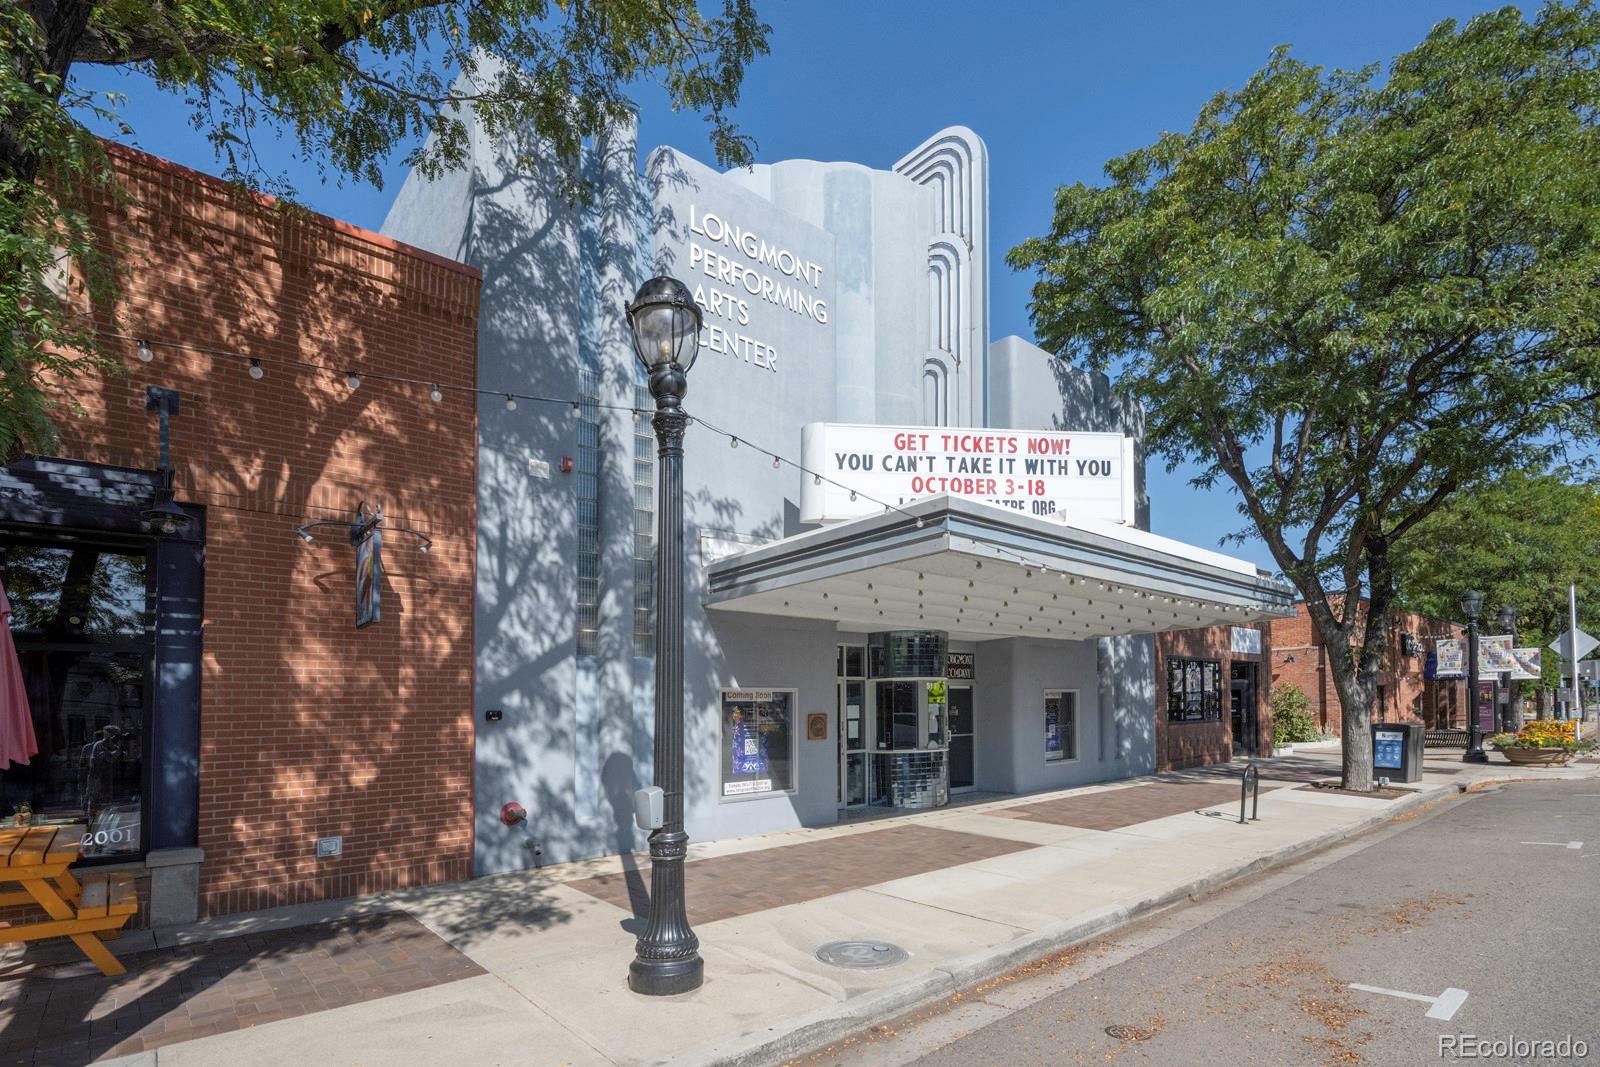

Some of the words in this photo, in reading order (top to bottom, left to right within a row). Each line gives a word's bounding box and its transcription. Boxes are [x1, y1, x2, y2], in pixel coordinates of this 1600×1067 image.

[690, 204, 823, 288] LONGMONT
[690, 242, 828, 324] PERFORMING
[693, 283, 749, 326] ARTS
[894, 433, 930, 452] GET
[942, 434, 1018, 454] TICKETS
[1027, 437, 1071, 455] NOW!
[835, 452, 874, 471] YOU
[882, 454, 936, 473] CAN'T
[945, 456, 992, 474] TAKE
[998, 457, 1016, 475] IT
[1025, 458, 1069, 476] WITH
[1076, 459, 1112, 477] YOU
[911, 476, 998, 495] OCTOBER
[1005, 478, 1046, 496] 3-18
[727, 691, 754, 700] Coming
